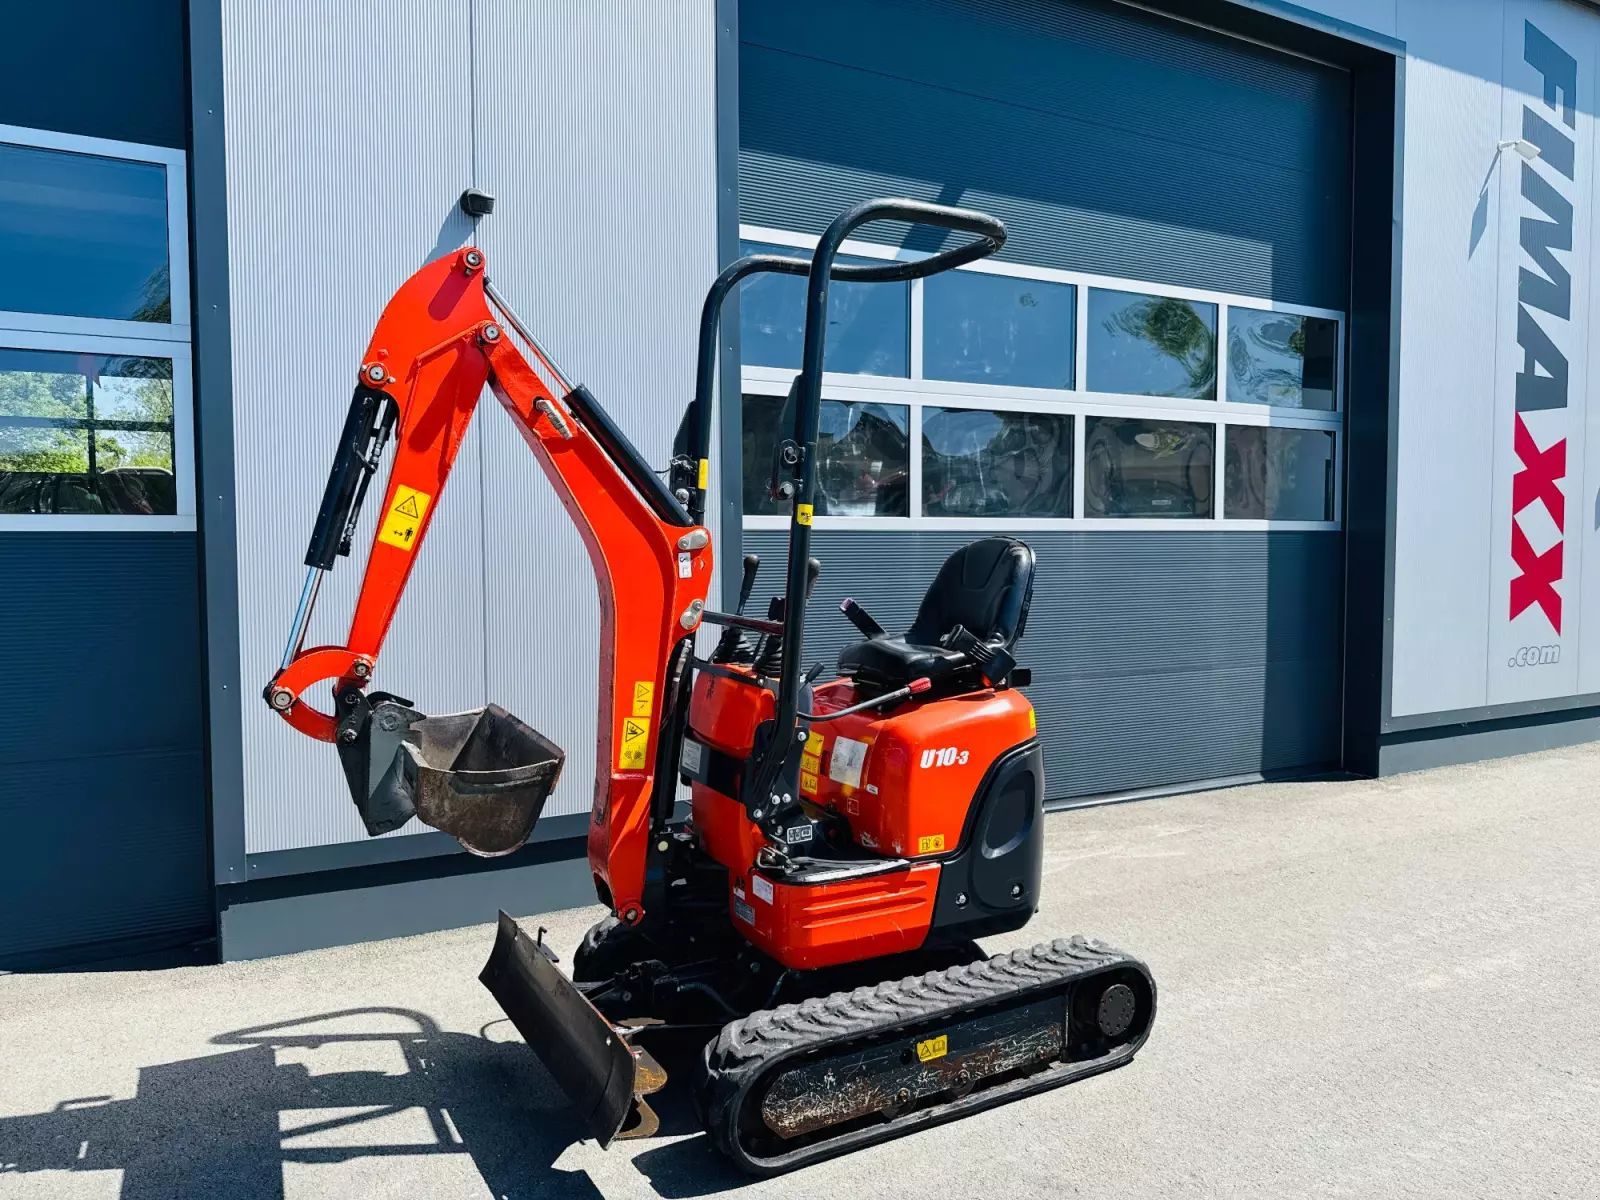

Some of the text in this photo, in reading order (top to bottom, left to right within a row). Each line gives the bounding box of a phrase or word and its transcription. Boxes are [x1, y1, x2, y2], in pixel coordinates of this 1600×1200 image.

[1509, 18, 1577, 637] FIMAXX
[1507, 644, 1561, 668] .com
[919, 746, 970, 769] U10-3
